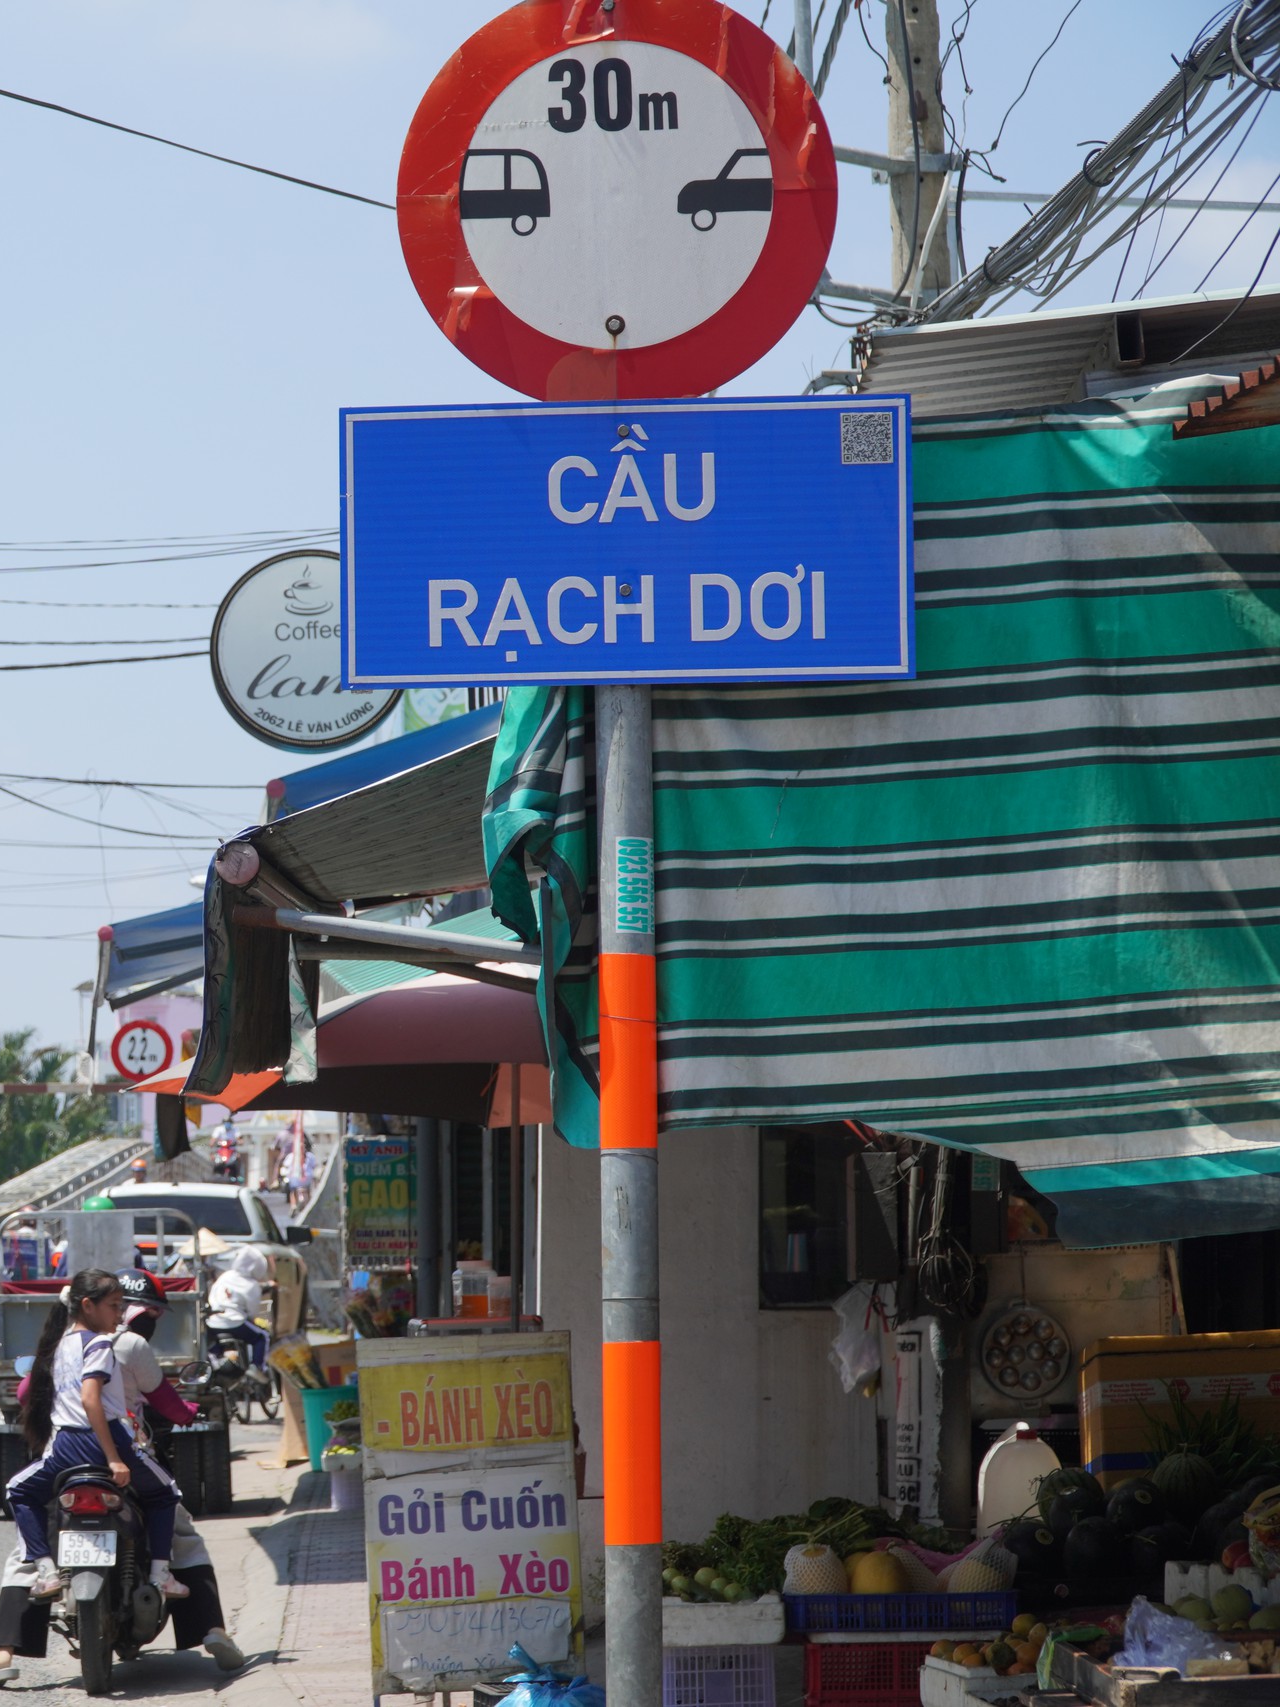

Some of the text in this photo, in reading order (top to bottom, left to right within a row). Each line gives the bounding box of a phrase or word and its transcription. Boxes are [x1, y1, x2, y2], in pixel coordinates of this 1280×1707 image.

[547, 57, 679, 133] 30m
[548, 424, 716, 525] CẦU
[275, 621, 341, 641] Coffee
[428, 564, 826, 662] RẠCH DƠI
[254, 707, 285, 728] 2062
[288, 718, 305, 733] LÊ
[617, 839, 649, 933] 0923.556.557
[400, 1376, 484, 1447] BÁNH
[493, 1369, 554, 1440] XÈO
[378, 1481, 567, 1536] Gỏi Cuốn
[381, 1551, 570, 1601] Bánh Xèo
